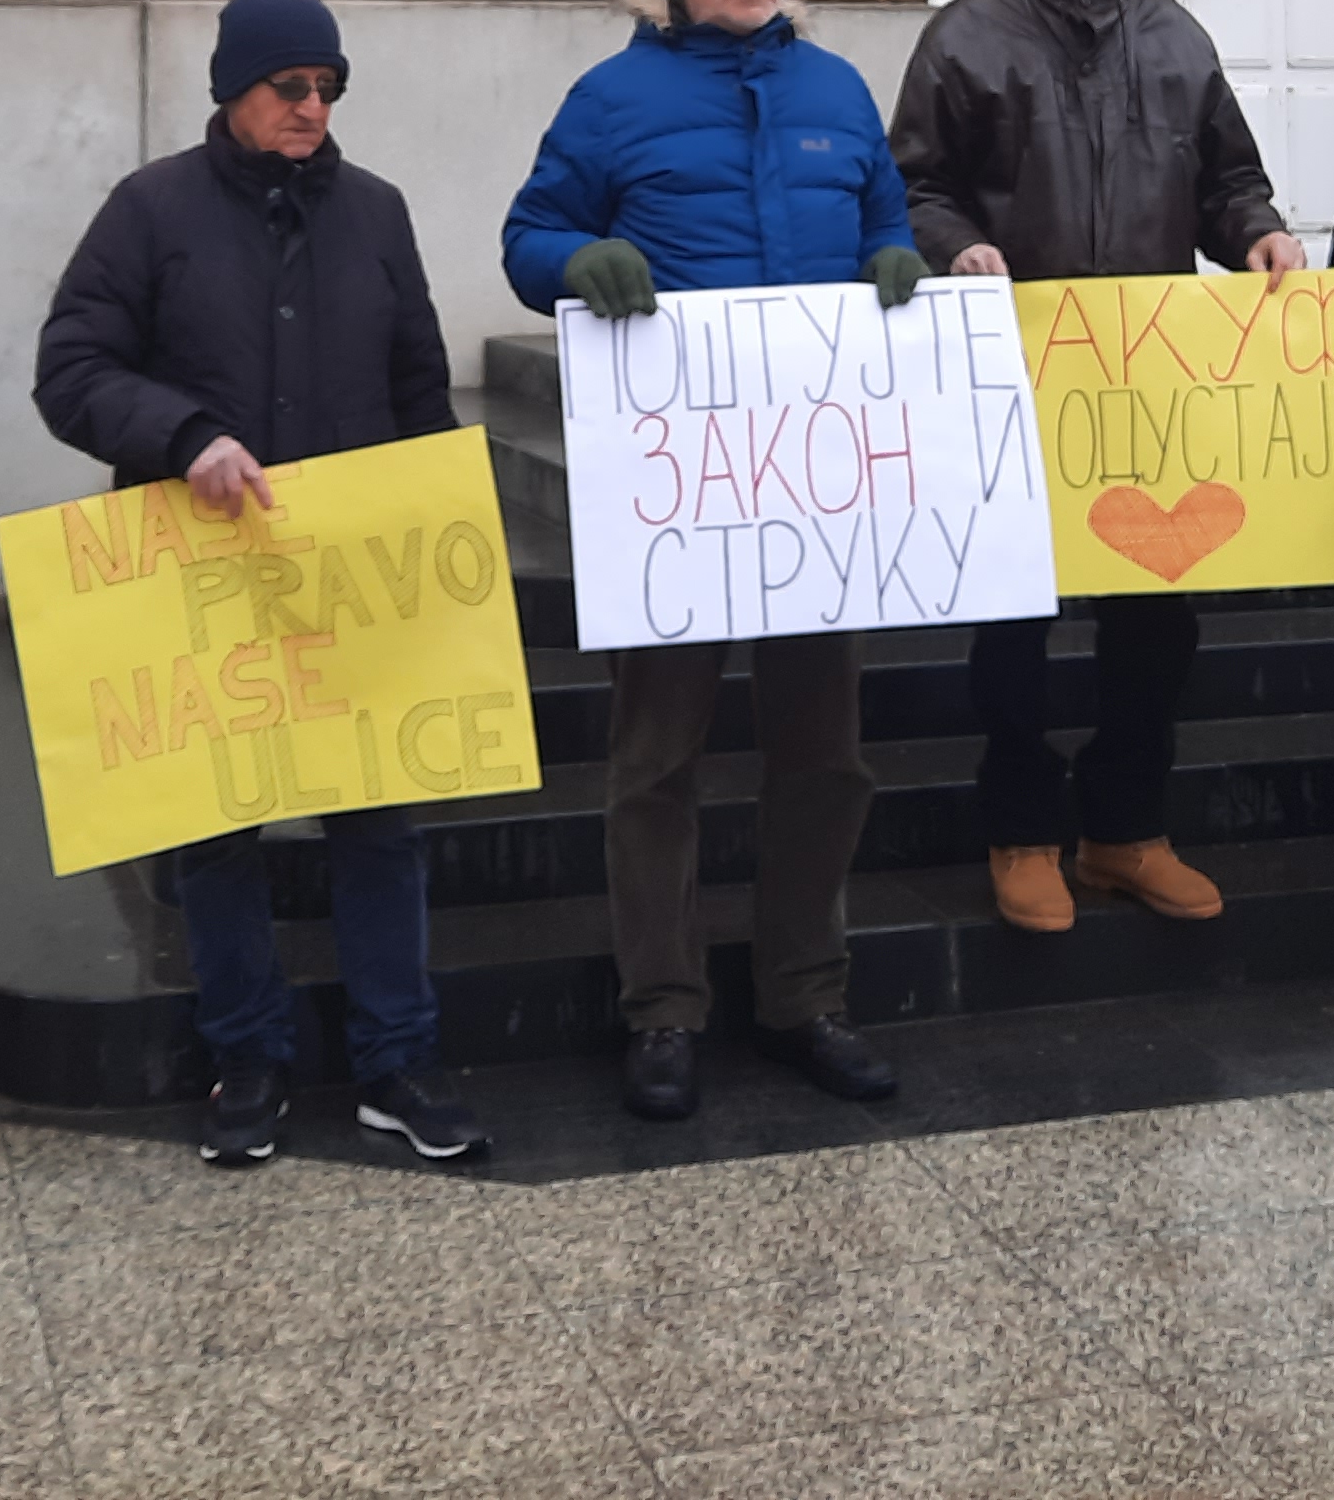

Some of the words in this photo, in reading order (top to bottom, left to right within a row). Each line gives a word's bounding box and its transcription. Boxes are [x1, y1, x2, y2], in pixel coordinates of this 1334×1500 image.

[562, 289, 1018, 419] ПОШТУЈТЕ
[632, 401, 917, 526] ЗАКОН
[180, 520, 496, 653] PRAVO
[643, 504, 979, 640] СТРУКУ
[208, 691, 523, 821] ULICE
